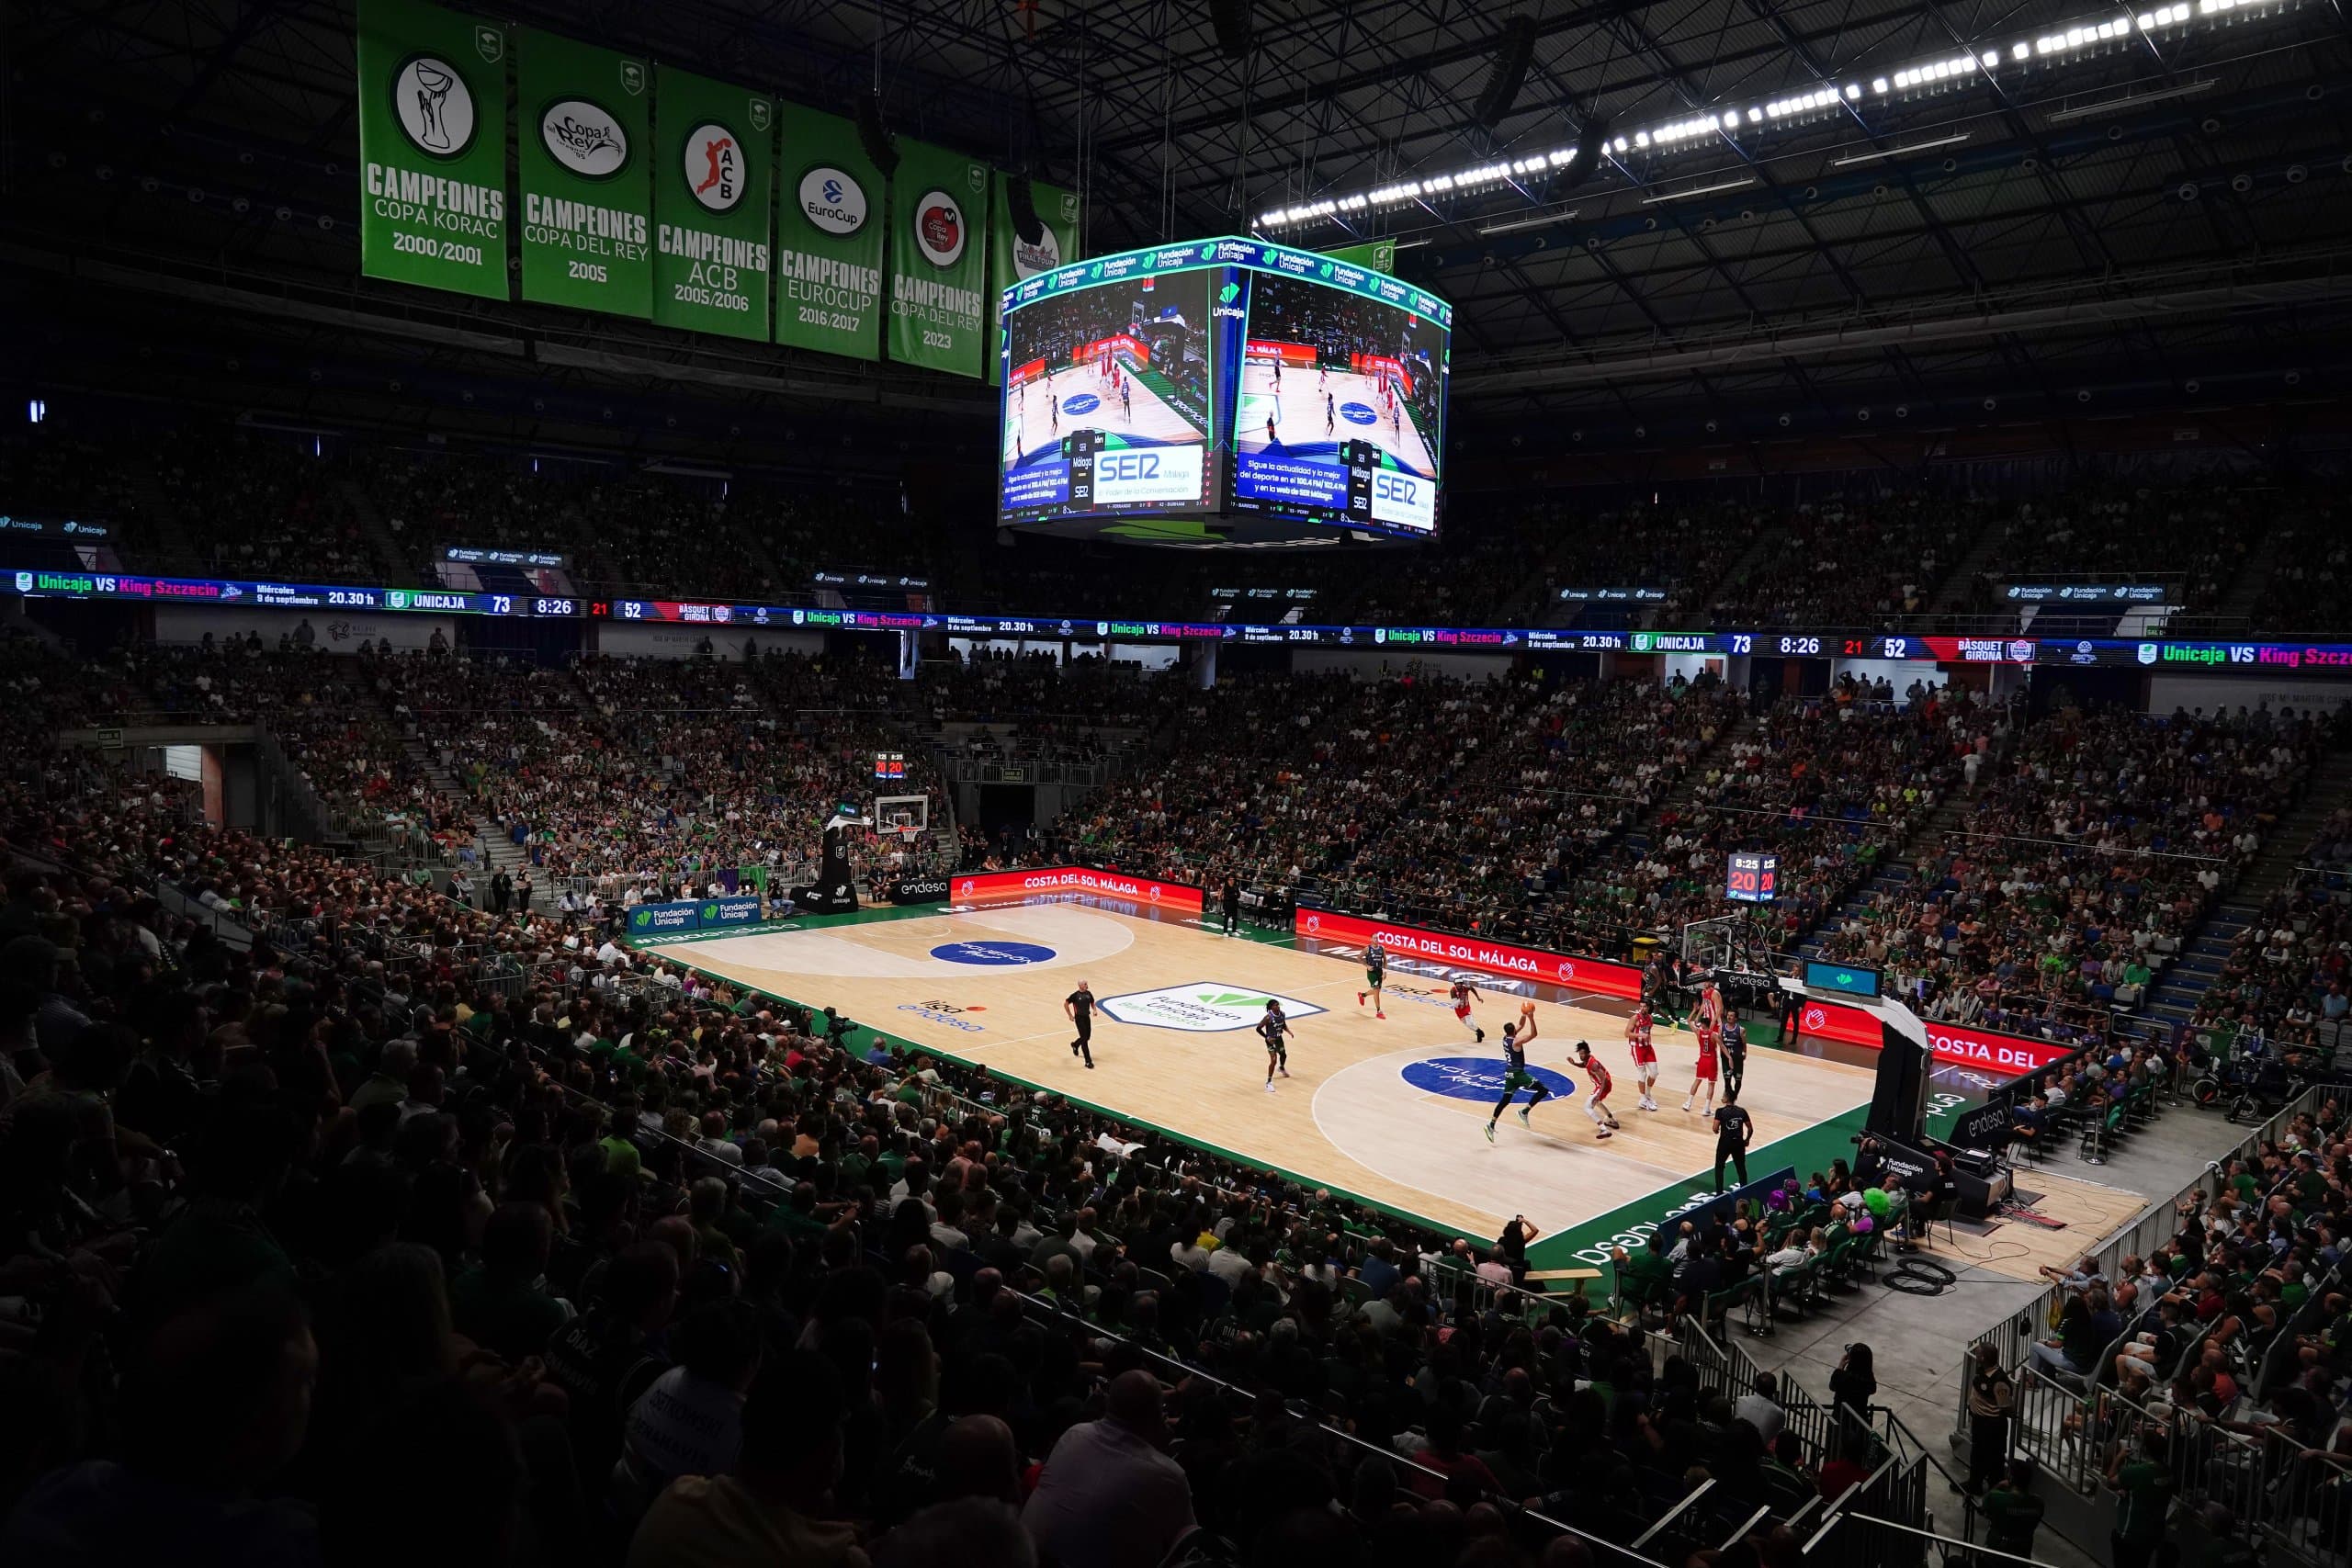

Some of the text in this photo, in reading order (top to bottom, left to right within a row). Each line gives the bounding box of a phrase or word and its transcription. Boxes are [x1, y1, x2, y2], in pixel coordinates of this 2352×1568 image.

[563, 116, 601, 140] Copa
[719, 149, 734, 199] ACB
[368, 163, 503, 221] CAMPEONES
[374, 199, 498, 239] COPA KORAC
[526, 194, 646, 244] CAMPEONES
[808, 202, 858, 227] EuroCup
[393, 232, 482, 265] 2000/2001
[525, 225, 648, 262] COPA DEL REY
[658, 224, 767, 273] CAMPEONES
[1218, 243, 1255, 255] Fundación
[1019, 253, 1037, 263] FINAL
[1158, 247, 1193, 259] Fundación
[1217, 251, 1245, 262] Unicaja
[1280, 251, 1314, 268] Fundación
[1104, 257, 1136, 269] Fundación
[1158, 257, 1183, 268] Unicaja
[1279, 260, 1305, 274] Unicaja
[569, 261, 607, 283] 2005
[688, 262, 738, 290] ACB
[782, 249, 878, 296] CAMPEONES
[1058, 266, 1086, 279] Fundación
[1103, 266, 1127, 277] Unicaja
[1334, 265, 1364, 282] Fundación
[1058, 276, 1078, 288] Unicaja
[1334, 274, 1356, 288] Unicaja
[1381, 280, 1406, 296] Fundación
[674, 284, 749, 311] 2005/2006
[787, 280, 872, 313] EUROCUP
[894, 274, 981, 318] CAMPEONES
[1381, 288, 1399, 301] Unicaja
[798, 307, 860, 332] 2016/2017
[890, 299, 982, 333] COPA DEL REY
[1213, 306, 1245, 319] Unicaja
[922, 331, 952, 349] 2023
[1072, 457, 1092, 470] Málaga
[1099, 453, 1160, 482] SER
[1248, 460, 1268, 470] Sigue
[1268, 462, 1275, 470] la
[1276, 464, 1311, 475] actualidad
[1323, 470, 1341, 480] mejor
[1239, 470, 1251, 479] del
[1252, 472, 1280, 482] deporte
[1289, 476, 1296, 484] el
[1254, 484, 1260, 492] y
[1375, 474, 1417, 506] SER
[12, 521, 107, 536] Unicaja Unicaja
[39, 574, 219, 597] Unicaja VS King Szczecin
[256, 584, 295, 595] Miércoles
[256, 594, 319, 606] 9 de septiembre
[328, 592, 374, 606] 20.30 h
[413, 594, 465, 610] UNICAJA
[492, 595, 510, 614] 73
[537, 599, 571, 615] 8:26
[593, 604, 607, 615] 21
[624, 603, 641, 618] 52
[678, 602, 710, 614] BÀSQUET
[807, 612, 922, 627] Unicaja VS King Szczecin
[947, 616, 975, 625] Miércoles
[999, 620, 1034, 632] 20.30 h
[962, 625, 991, 634] septiembre
[1111, 623, 1222, 638] Unicaja VS King Szczecin
[1289, 629, 1318, 641] 20.30 h
[1388, 629, 1501, 645] Unicaja VS King Szczecin
[1529, 631, 1557, 640] Miércoles
[1534, 640, 1575, 650] de septiembre
[1583, 636, 1621, 649] 20.30 h
[1657, 637, 1705, 650] UNICAJA
[1733, 636, 1751, 653] 73
[1781, 637, 1819, 654] 8:26
[1844, 640, 1862, 654] 21
[1884, 638, 1905, 658] 52
[1958, 637, 2003, 652] BÀSQUET
[1965, 649, 2003, 661] GIRONA
[2164, 645, 2226, 666] Unicaja
[2231, 646, 2255, 663] VS
[2258, 647, 2300, 668] King
[876, 761, 887, 773] 20
[889, 762, 902, 773] 20
[1736, 858, 1758, 870] 8:25
[901, 879, 947, 896] endesa
[1024, 874, 1138, 896] COSTA DEL SOL MÁLAGA
[1730, 871, 1756, 891] 20
[1760, 872, 1774, 891] 20
[653, 908, 695, 920] Fundación
[719, 901, 758, 913] Fundación
[720, 909, 749, 920] Unicaja
[654, 916, 684, 927] Unicaja
[1376, 931, 1538, 973] COSTA DEL SOL MÁLAGA
[1318, 945, 1523, 991] MLAGA
[1728, 975, 1770, 987] endesa
[920, 999, 967, 1014] liga
[1117, 1001, 1207, 1028] Baloncesto
[1146, 1002, 1210, 1021] Unicaja
[1151, 996, 1242, 1021] Fundación
[897, 1004, 986, 1032] endesa
[1998, 1048, 2040, 1069] DEL
[1418, 1060, 1565, 1100] HIGUE
[1968, 1109, 2005, 1137] endesa
[1886, 1164, 1913, 1177] Unicaja
[1888, 1157, 1924, 1174] Fundación
